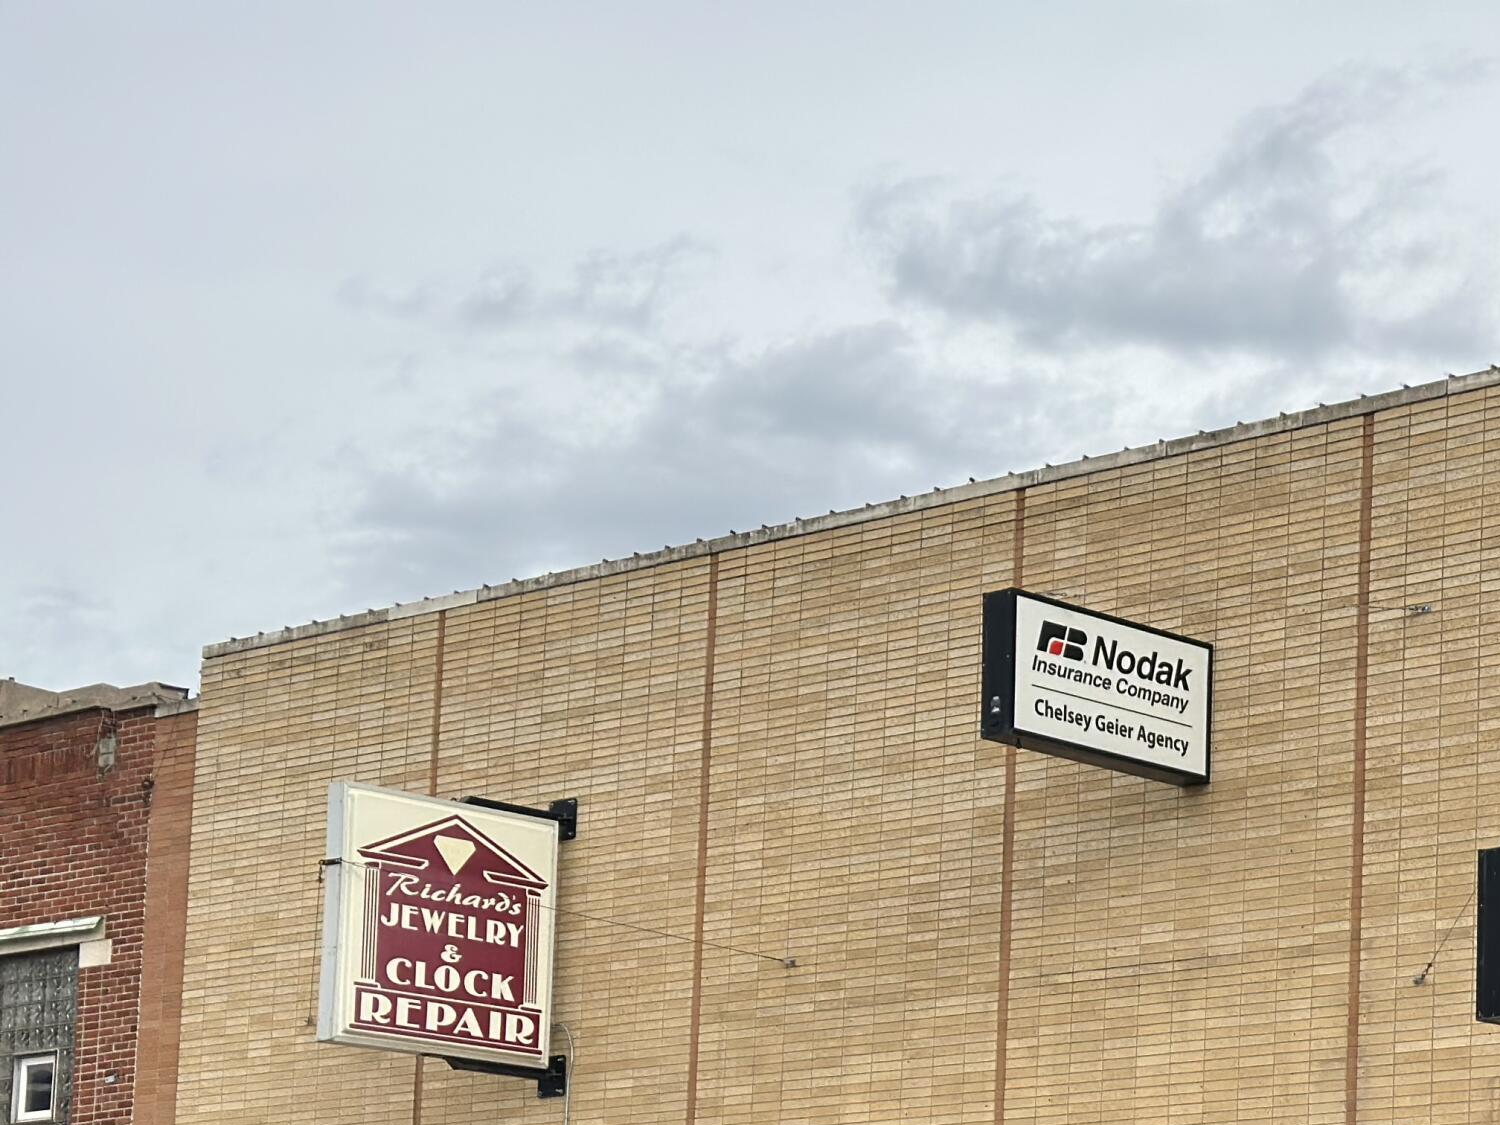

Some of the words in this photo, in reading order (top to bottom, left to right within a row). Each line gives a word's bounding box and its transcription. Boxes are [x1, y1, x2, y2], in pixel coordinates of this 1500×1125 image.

[1032, 655, 1112, 691] Insurance
[1116, 678, 1190, 714] Company
[1092, 634, 1193, 692] Nodak
[1034, 699, 1092, 732] Chelsey
[1095, 714, 1134, 739] Geier
[1136, 725, 1189, 757] Agency
[386, 872, 522, 916] Richard's
[380, 903, 525, 948] JEWELRY
[440, 944, 463, 963] &
[386, 958, 515, 1002] CLOCK
[359, 991, 536, 1045] REPAIR
